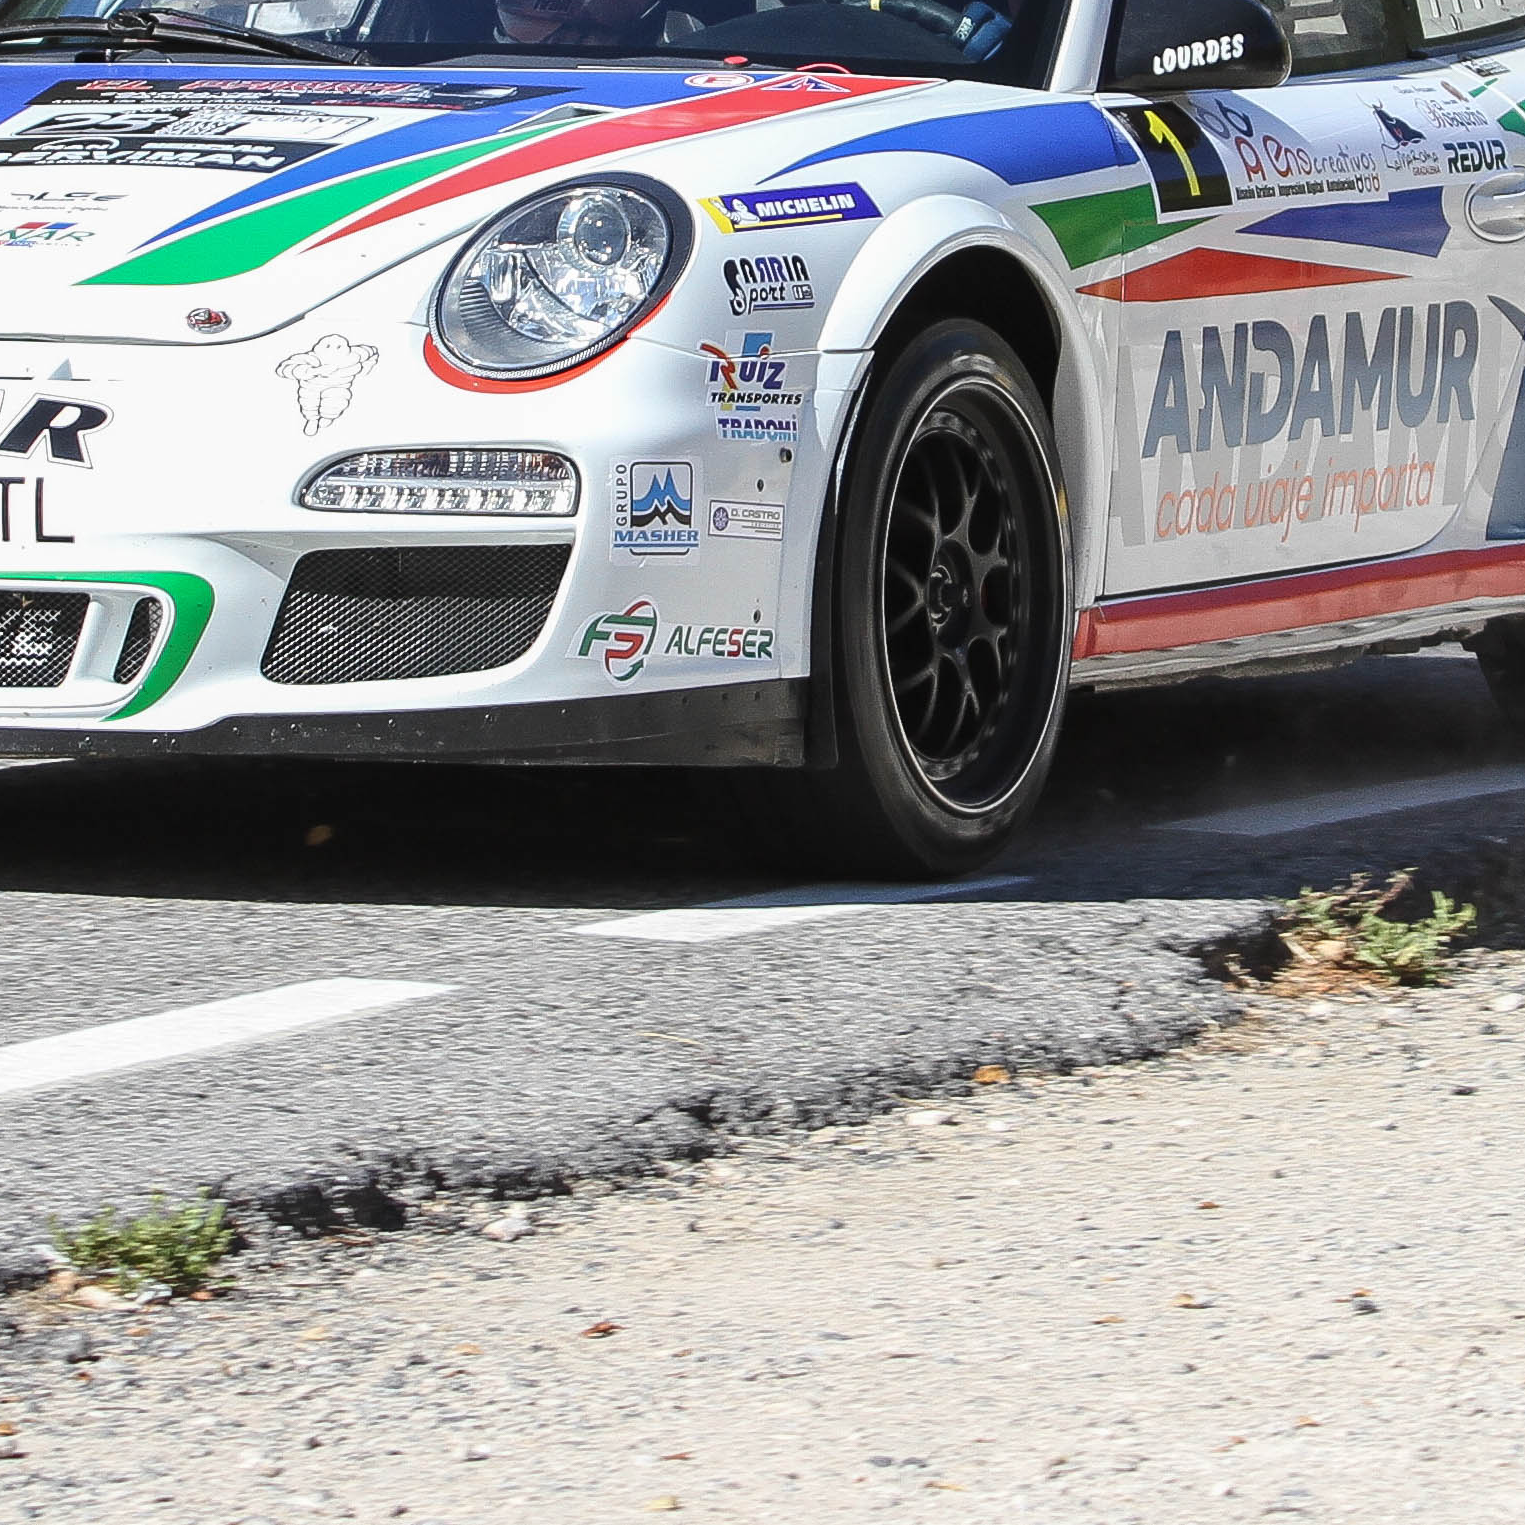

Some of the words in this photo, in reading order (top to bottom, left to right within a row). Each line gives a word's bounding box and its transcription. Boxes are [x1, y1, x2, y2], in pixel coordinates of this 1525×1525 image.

[1153, 33, 1244, 75] LOURDES
[1144, 110, 1200, 197] 1
[1313, 142, 1376, 174] creativos
[1442, 140, 1508, 174] REDUR
[756, 192, 855, 217] MICHELIN
[1141, 300, 1479, 459] ANDAMUR
[711, 392, 803, 405] TRANSPORTES
[615, 464, 628, 526] GRUPO
[1156, 472, 1236, 538] cada
[1321, 452, 1436, 533] importa
[742, 509, 781, 521] CASTRO
[614, 529, 698, 543] MASHER
[665, 623, 775, 660] ALFESER
